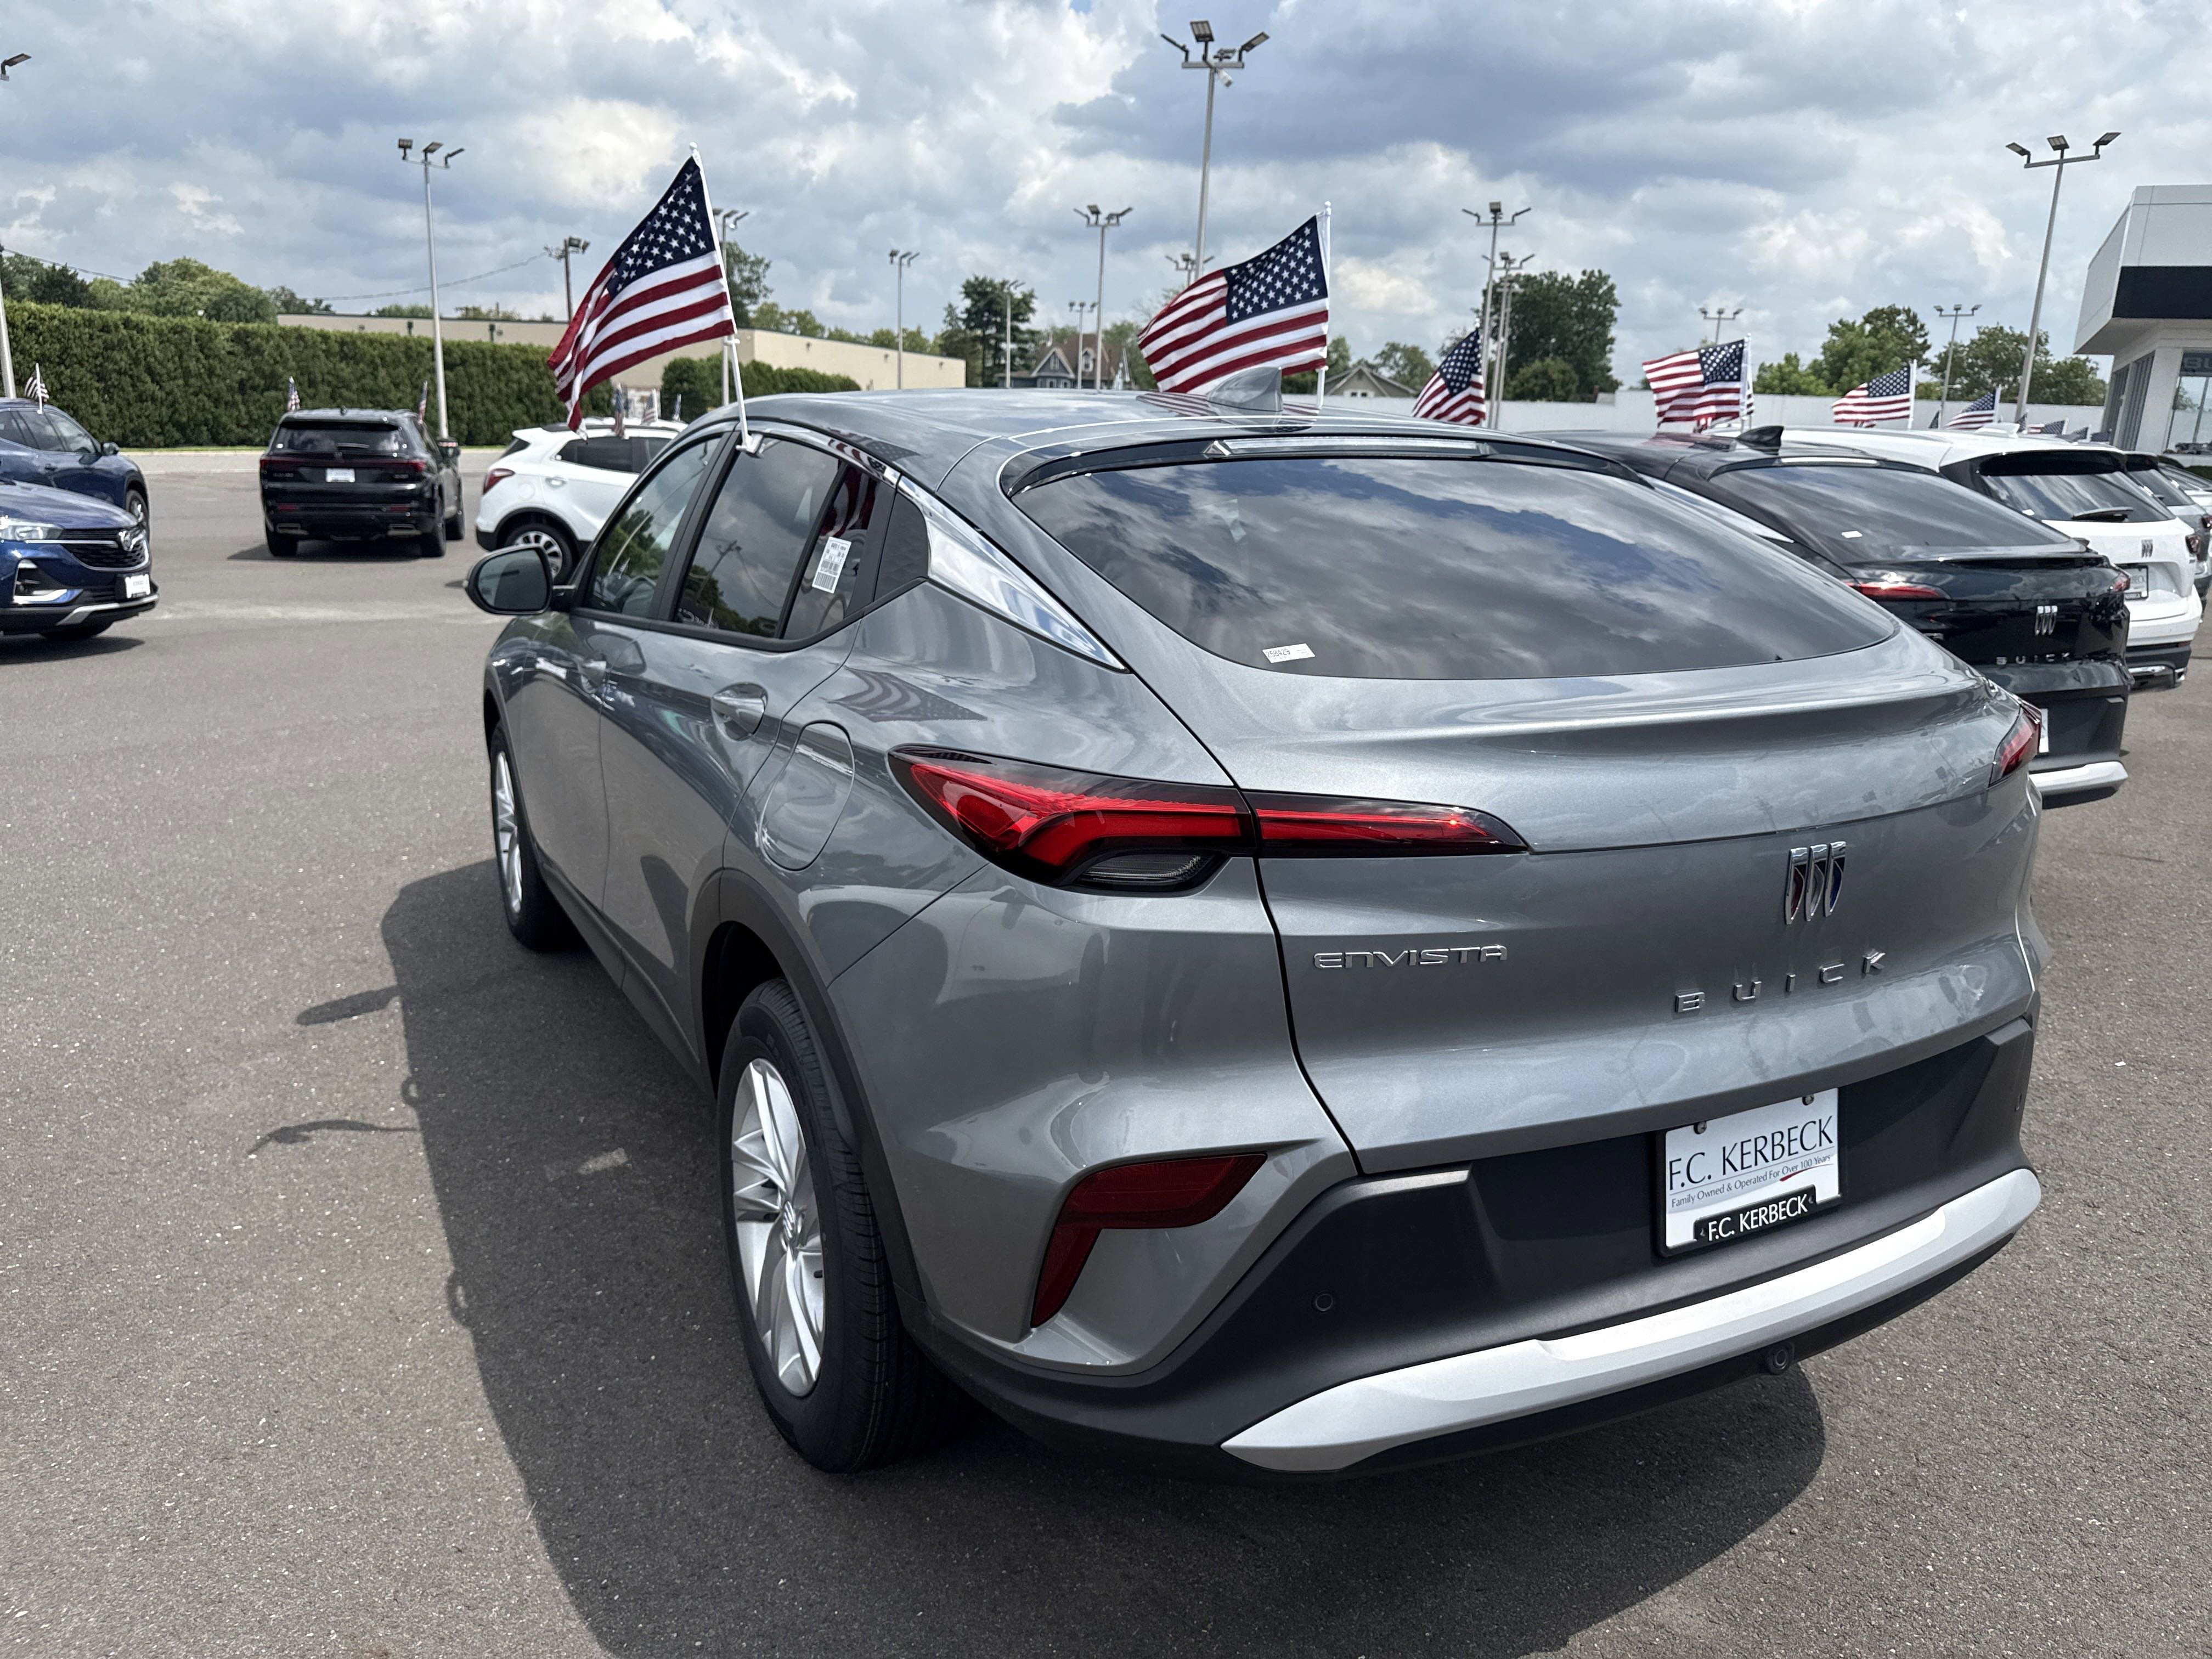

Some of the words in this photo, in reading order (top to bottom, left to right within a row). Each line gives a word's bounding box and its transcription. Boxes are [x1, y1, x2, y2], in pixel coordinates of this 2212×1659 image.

[1314, 945, 1508, 969] ENVISTA
[1675, 950, 1886, 1013] BUICK
[1669, 1152, 1712, 1190] F.C.
[1722, 1115, 1833, 1176] KERBECK
[1672, 1193, 1696, 1208] Family
[1697, 1183, 1724, 1200] Owned
[1726, 1183, 1733, 1192] &
[1734, 1171, 1768, 1190] Operated
[1769, 1170, 1780, 1179] For
[1782, 1164, 1798, 1175] Over
[1800, 1159, 1813, 1170] 100
[1814, 1154, 1831, 1165] Years
[1708, 1217, 1735, 1242] F.C.
[1739, 1193, 1808, 1232] KERBECK
